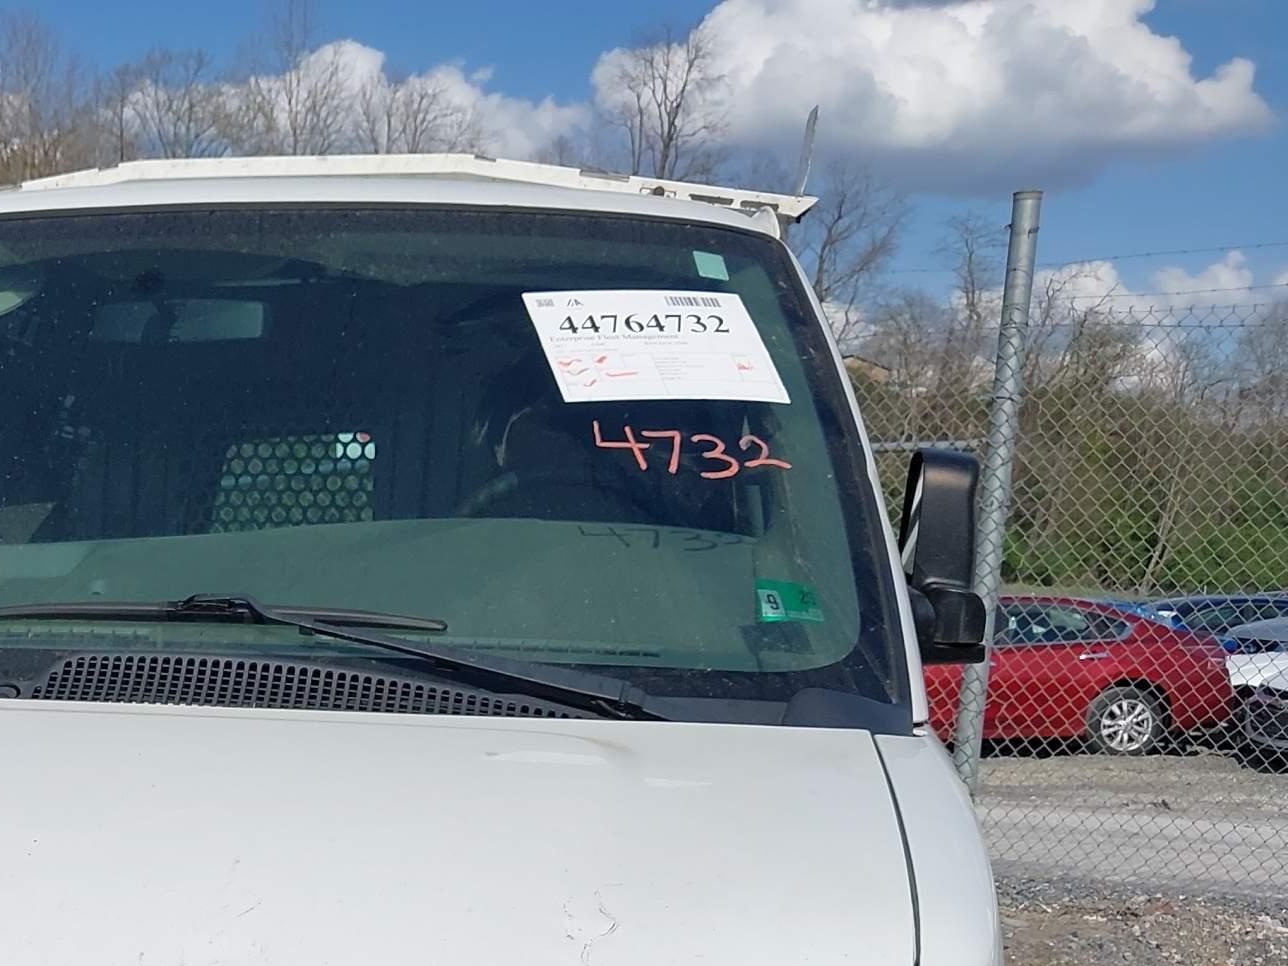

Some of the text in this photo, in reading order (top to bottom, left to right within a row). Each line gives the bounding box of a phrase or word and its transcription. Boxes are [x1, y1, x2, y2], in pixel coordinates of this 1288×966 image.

[559, 313, 730, 334] 44764732
[592, 419, 793, 479] 4732
[766, 593, 780, 610] 9
